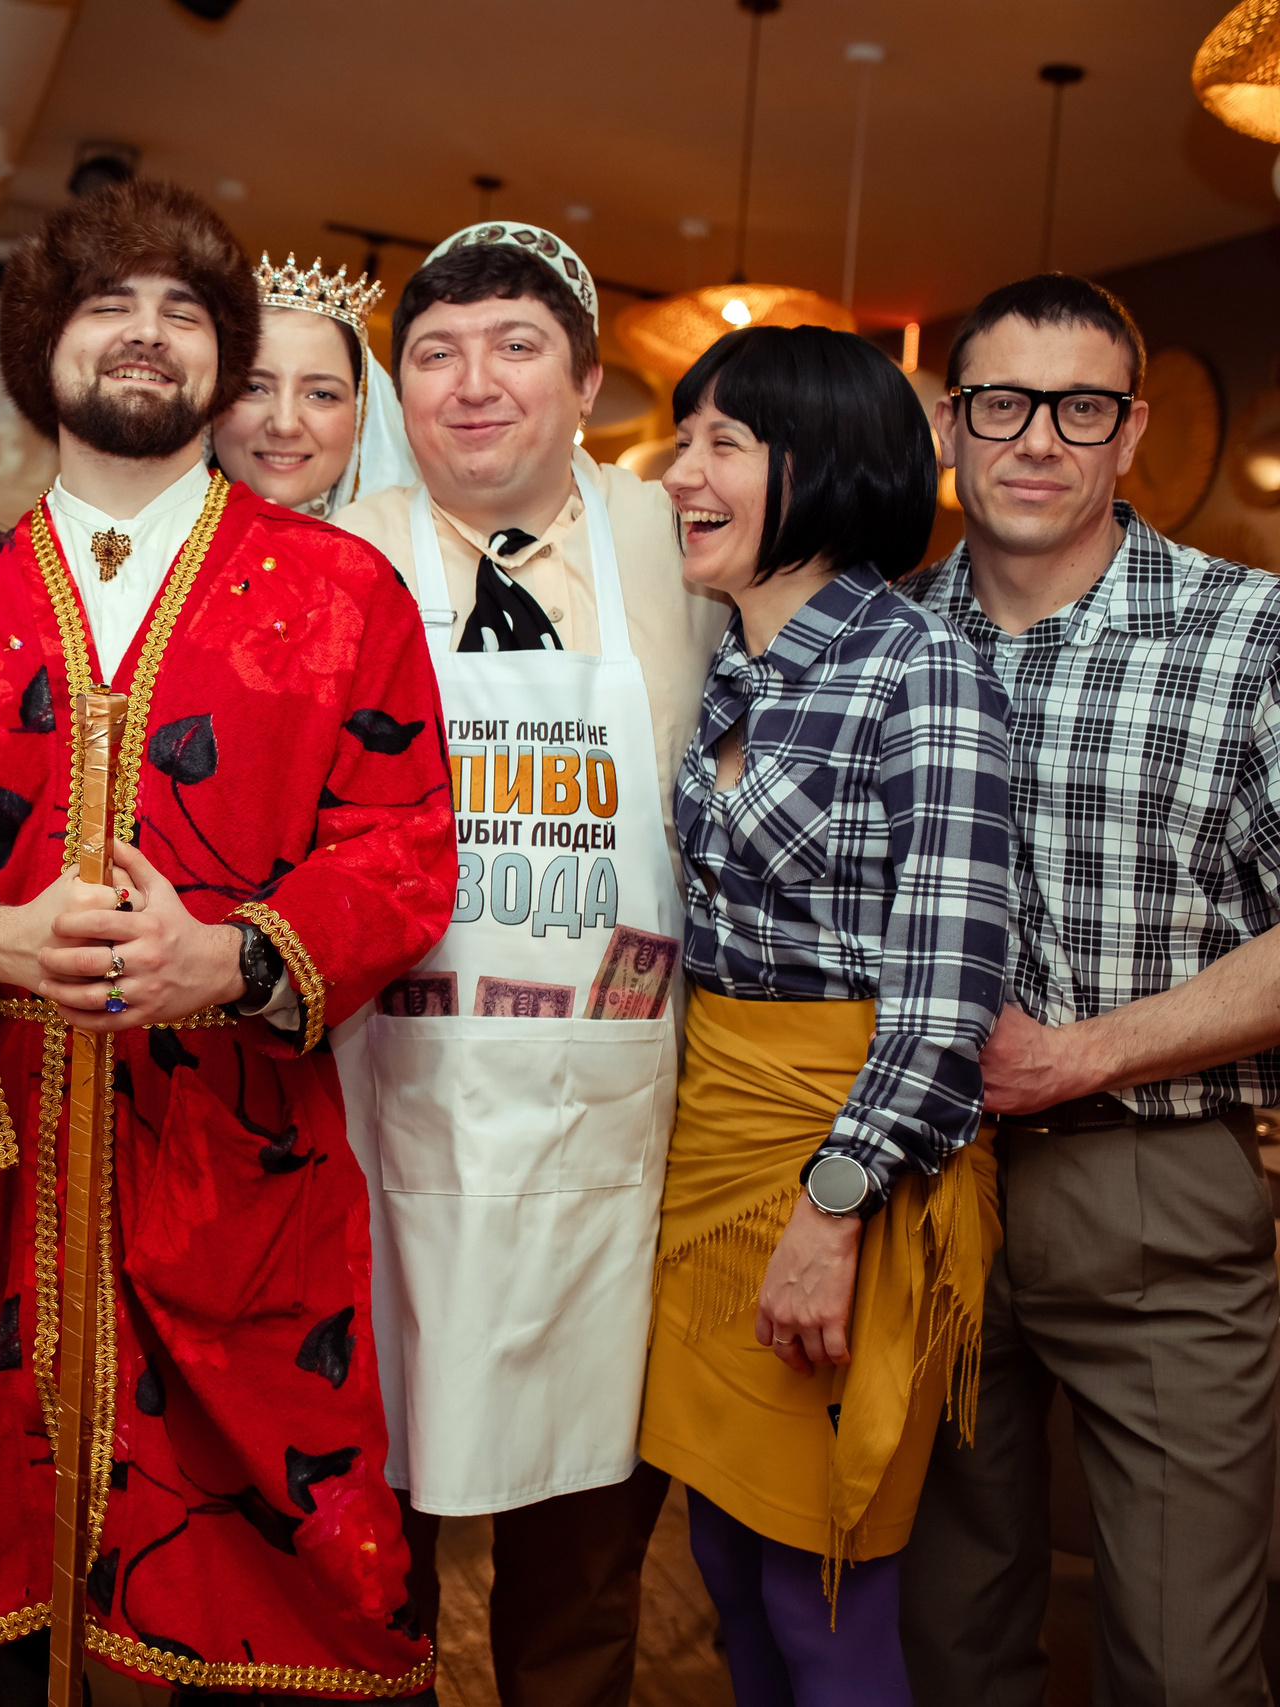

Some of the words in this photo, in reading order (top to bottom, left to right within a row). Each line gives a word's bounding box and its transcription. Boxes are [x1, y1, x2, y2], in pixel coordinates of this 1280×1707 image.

[448, 720, 509, 741] ГУБИТ
[516, 718, 585, 745] ЛЮДЕЙ
[588, 725, 608, 746] НЕ
[448, 744, 619, 818] ПИВО
[456, 819, 523, 846] УБИТ
[531, 821, 616, 853] ЛЮДЕЙ
[450, 852, 619, 939] ВОДА
